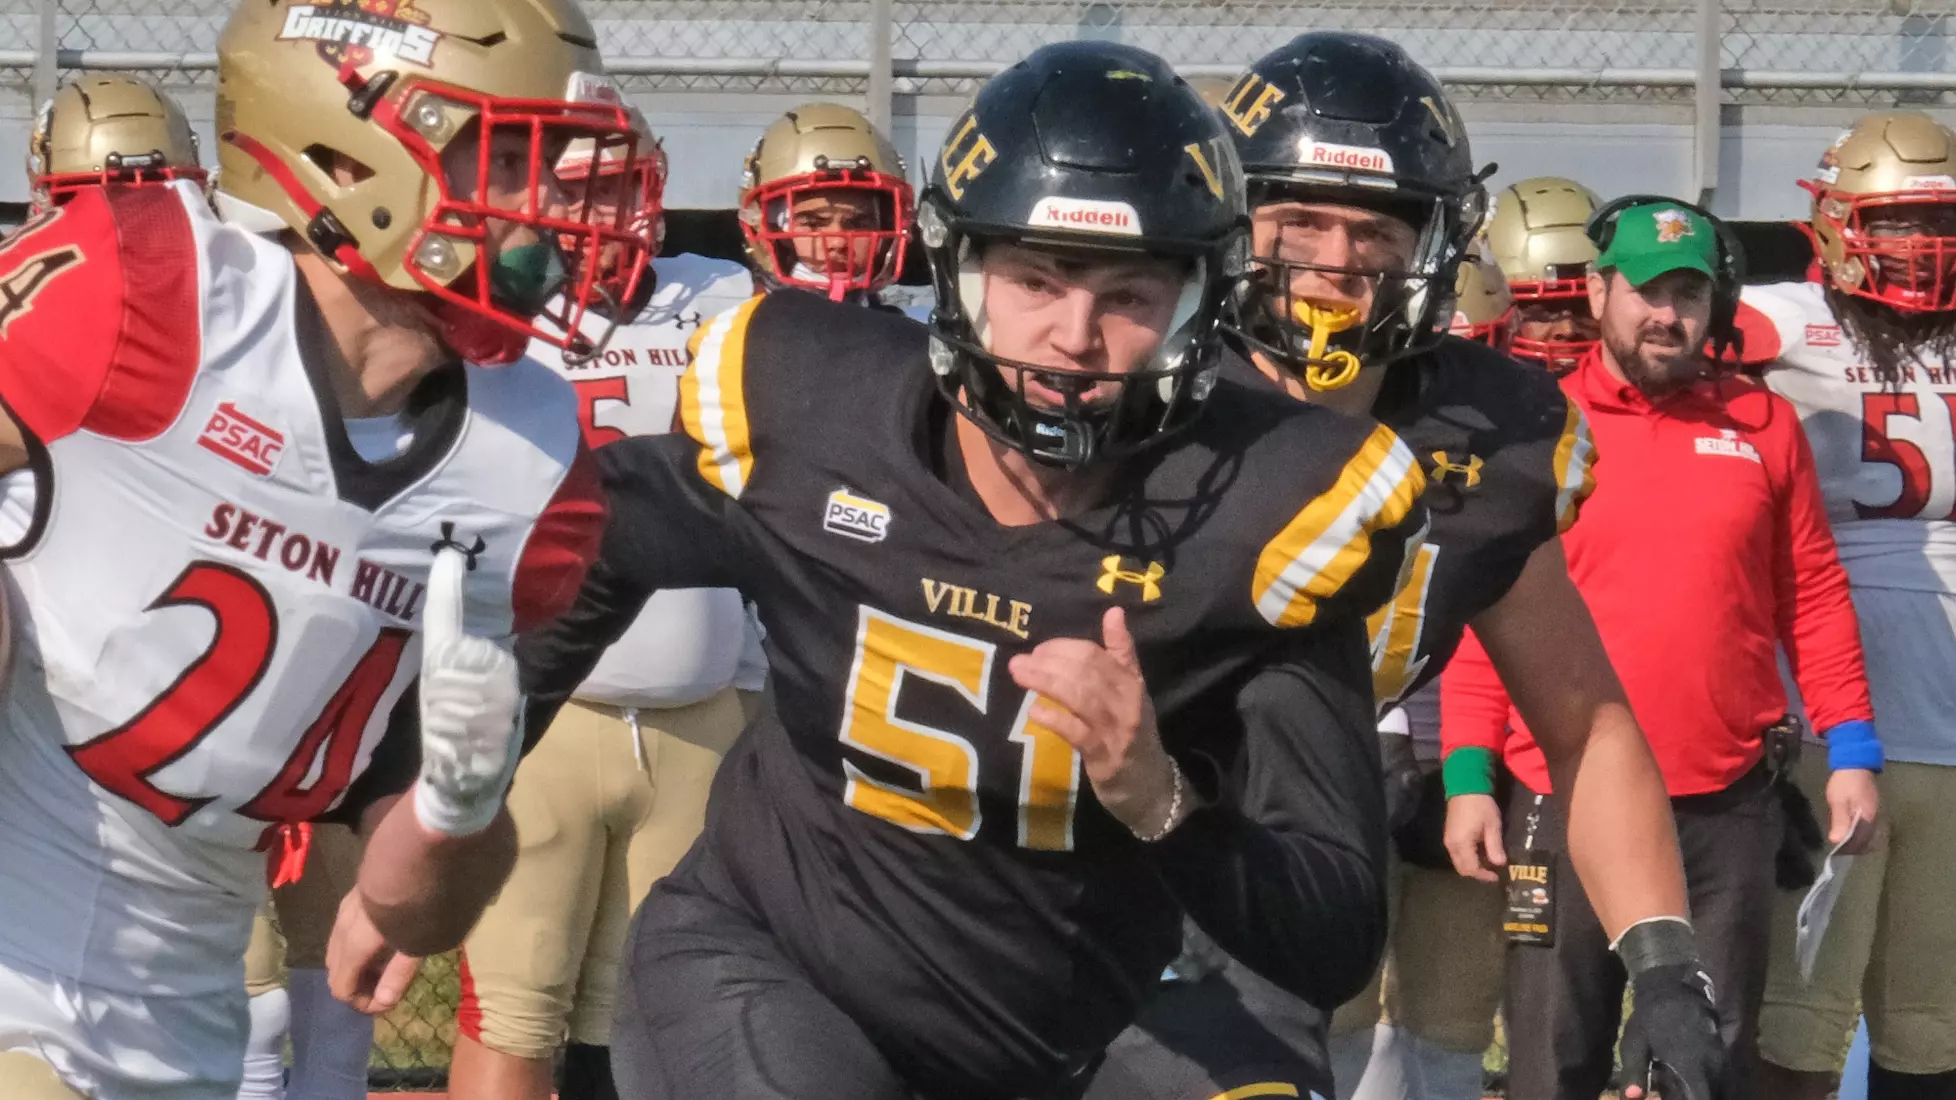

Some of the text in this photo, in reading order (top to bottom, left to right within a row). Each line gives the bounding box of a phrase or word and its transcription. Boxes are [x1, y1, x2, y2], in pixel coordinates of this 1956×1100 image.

[1313, 148, 1384, 169] Riddell
[1046, 206, 1129, 227] Riddell
[1805, 328, 1841, 341] PSAC
[648, 348, 691, 366] HIL
[204, 412, 283, 467] PSAC
[1852, 391, 1956, 520] 5
[829, 503, 884, 532] PSAC
[204, 503, 427, 621] SETON HILL
[921, 577, 1033, 640] VILLE
[61, 560, 414, 828] 24
[838, 603, 1082, 852] 51
[1508, 865, 1548, 884] VILLE
